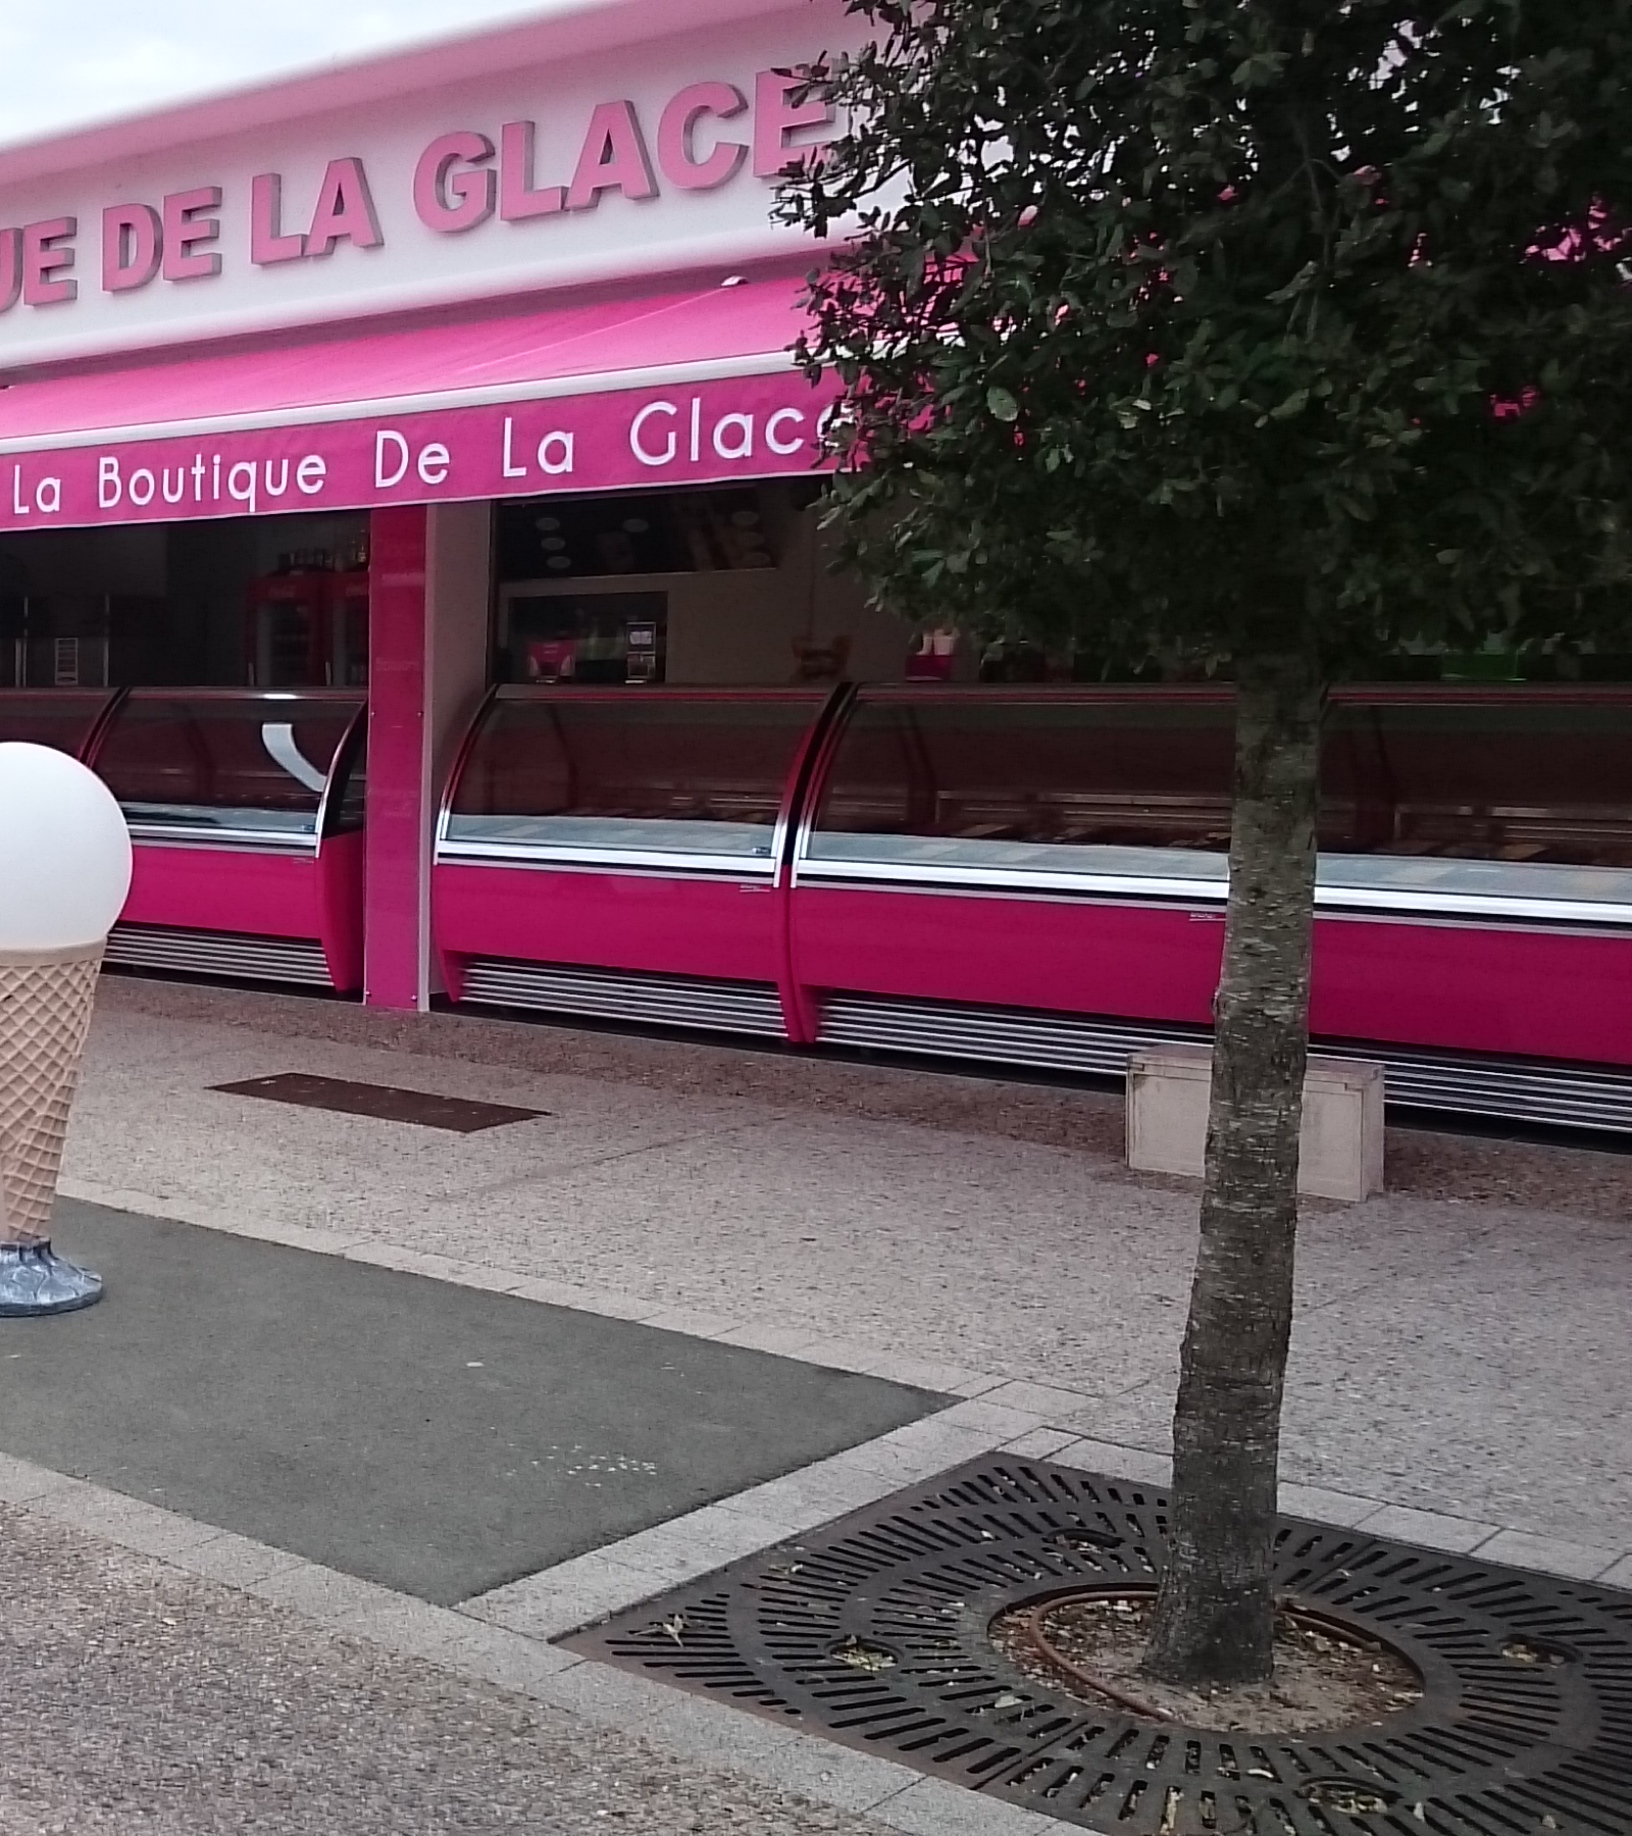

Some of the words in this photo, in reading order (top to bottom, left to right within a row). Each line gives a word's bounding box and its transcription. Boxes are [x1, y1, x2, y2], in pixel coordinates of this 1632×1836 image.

[103, 186, 222, 294] DE
[251, 157, 384, 266] LA
[413, 58, 846, 233] GLACE
[14, 464, 62, 515] La
[99, 453, 327, 513] Boutique
[375, 429, 450, 489] De
[503, 417, 574, 479] La
